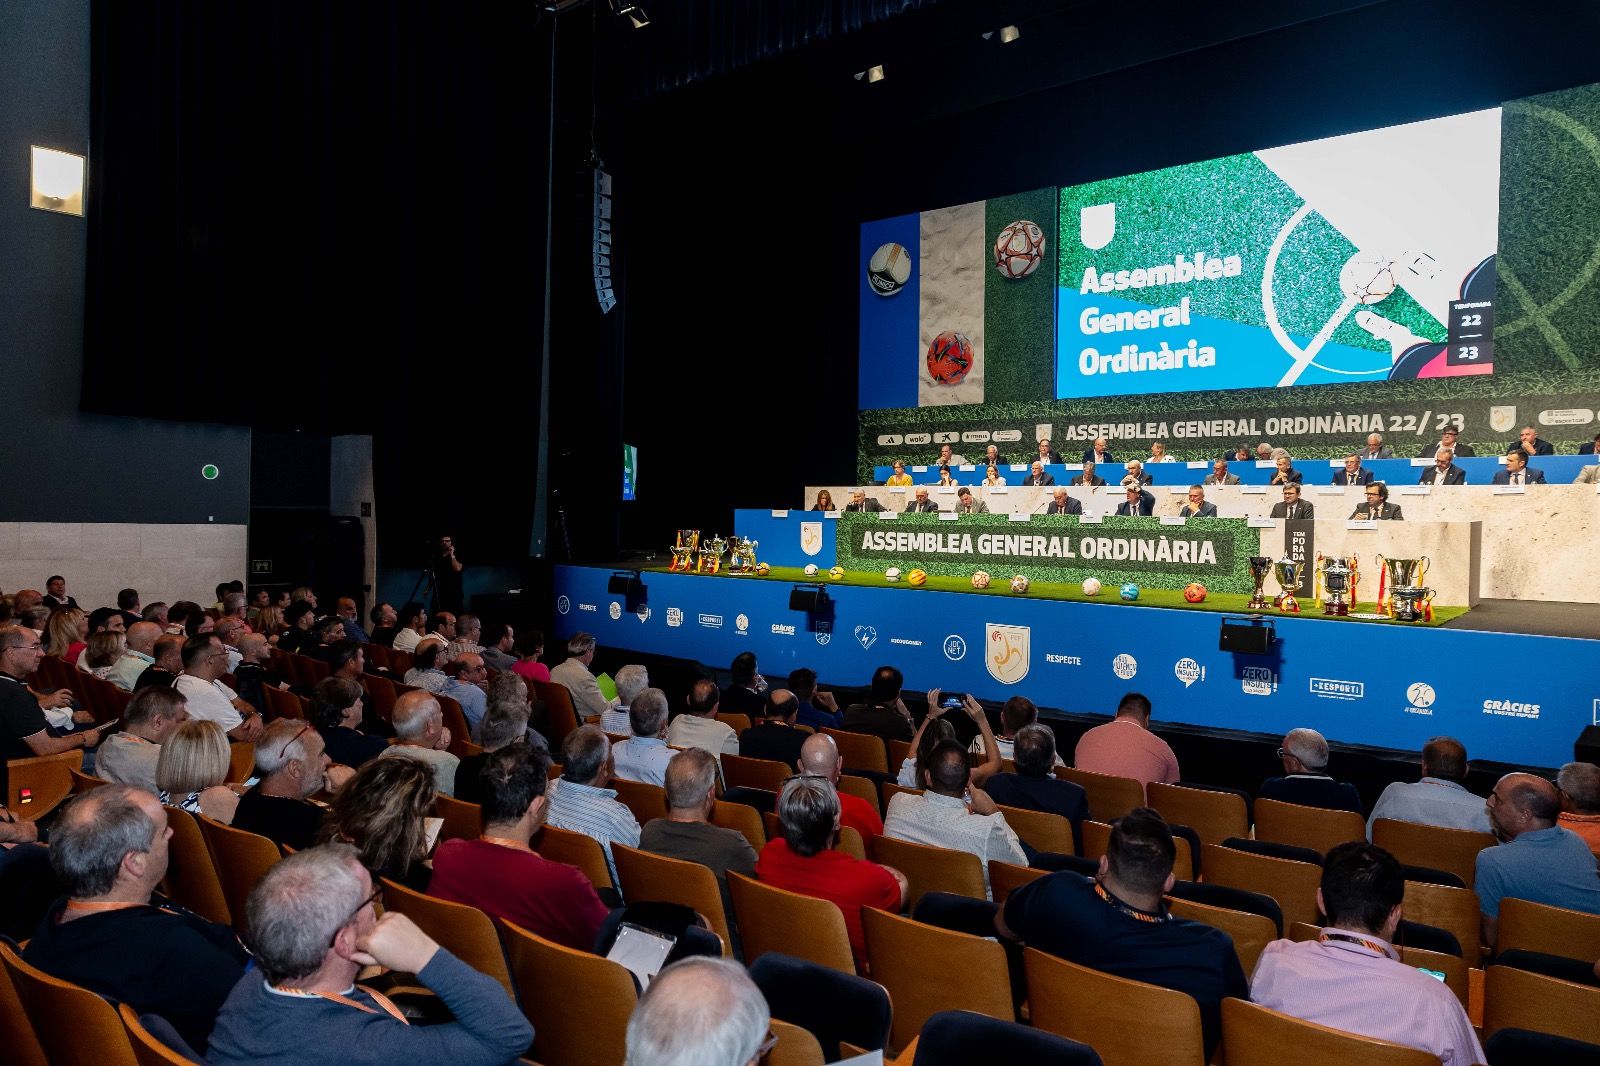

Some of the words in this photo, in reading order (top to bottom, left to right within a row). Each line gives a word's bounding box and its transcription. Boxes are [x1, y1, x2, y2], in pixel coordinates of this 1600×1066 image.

[1080, 252, 1242, 294] Assemblea
[1079, 297, 1190, 335] General
[1461, 315, 1482, 326] 22
[1079, 339, 1215, 376] Ordinària
[1459, 346, 1479, 359] 23
[1066, 420, 1168, 441] ASSEMBLEA
[1173, 417, 1261, 438] GENERAL
[1265, 412, 1384, 435] ORDINÀRIA
[862, 531, 973, 554] ASSEMBLEA
[977, 534, 1075, 559] GENERAL
[1080, 535, 1217, 565] ORDINÀRIA
[1046, 654, 1081, 666] RESPECTE
[1177, 661, 1198, 670] ZERO
[1243, 668, 1269, 680] ZERO
[1483, 700, 1540, 715] GRÀCIES
